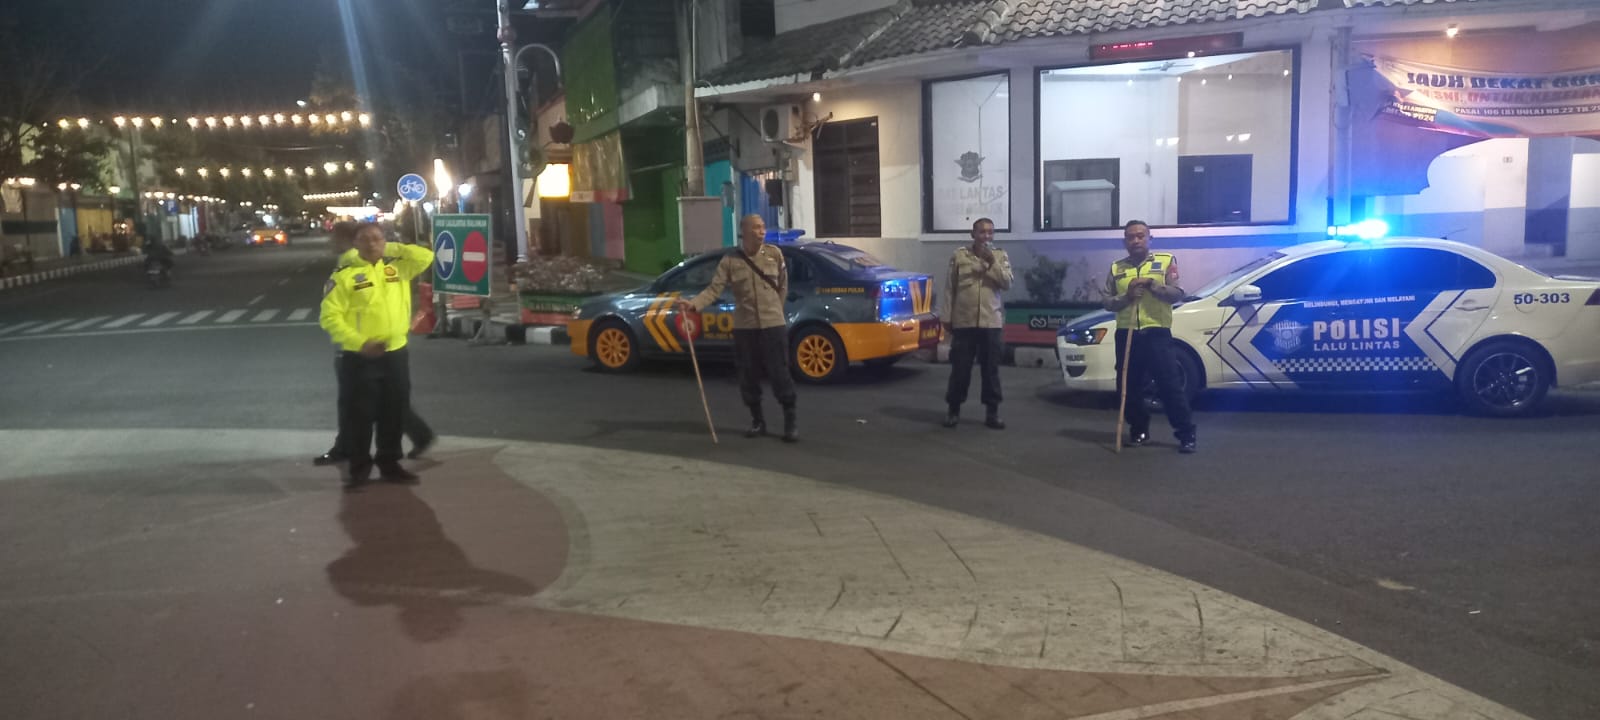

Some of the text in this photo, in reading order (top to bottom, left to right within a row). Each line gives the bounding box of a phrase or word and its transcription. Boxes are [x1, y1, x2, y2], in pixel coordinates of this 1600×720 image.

[1456, 107, 1480, 115] PASAL
[1514, 293, 1570, 304] 50-303
[1313, 318, 1400, 340] POLISI
[1313, 340, 1400, 352] LALU LINTAS
